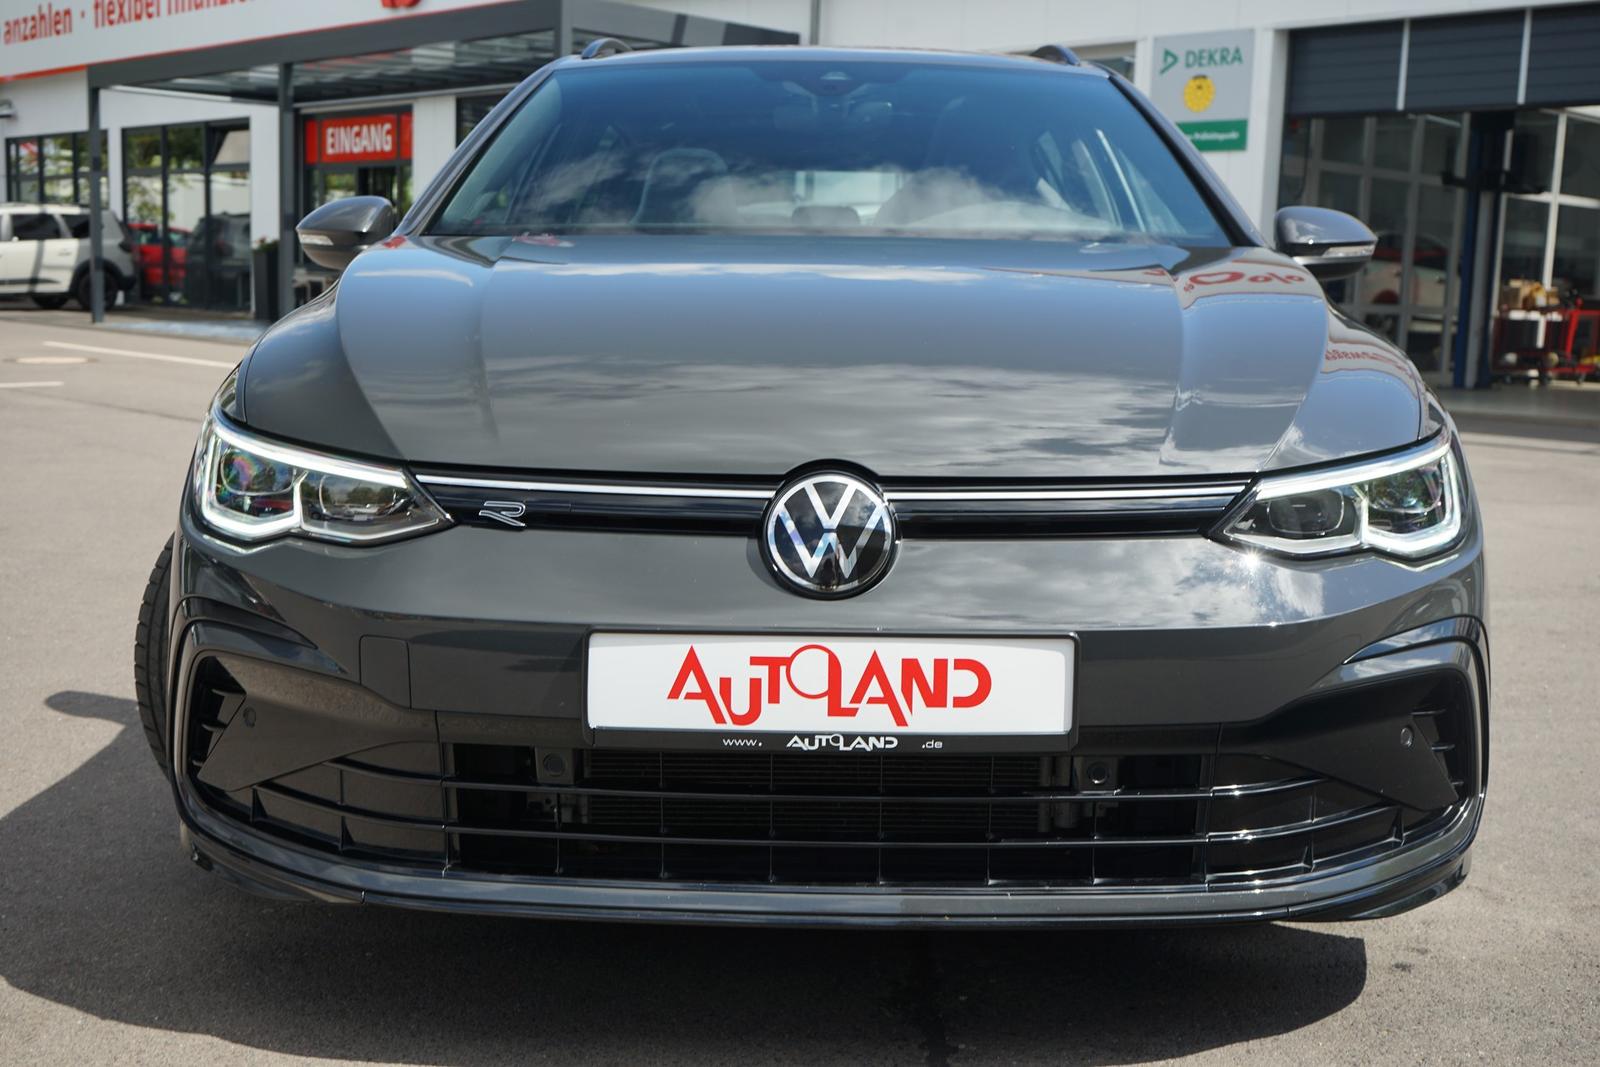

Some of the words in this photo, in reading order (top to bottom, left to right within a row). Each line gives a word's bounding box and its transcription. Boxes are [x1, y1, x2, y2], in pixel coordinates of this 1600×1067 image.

[4, 2, 73, 45] anzahlen
[1184, 46, 1244, 69] DEKRA
[326, 123, 393, 155] EINGANG
[667, 644, 992, 726] AUTOLAND
[786, 733, 899, 751] AUTOLAND
